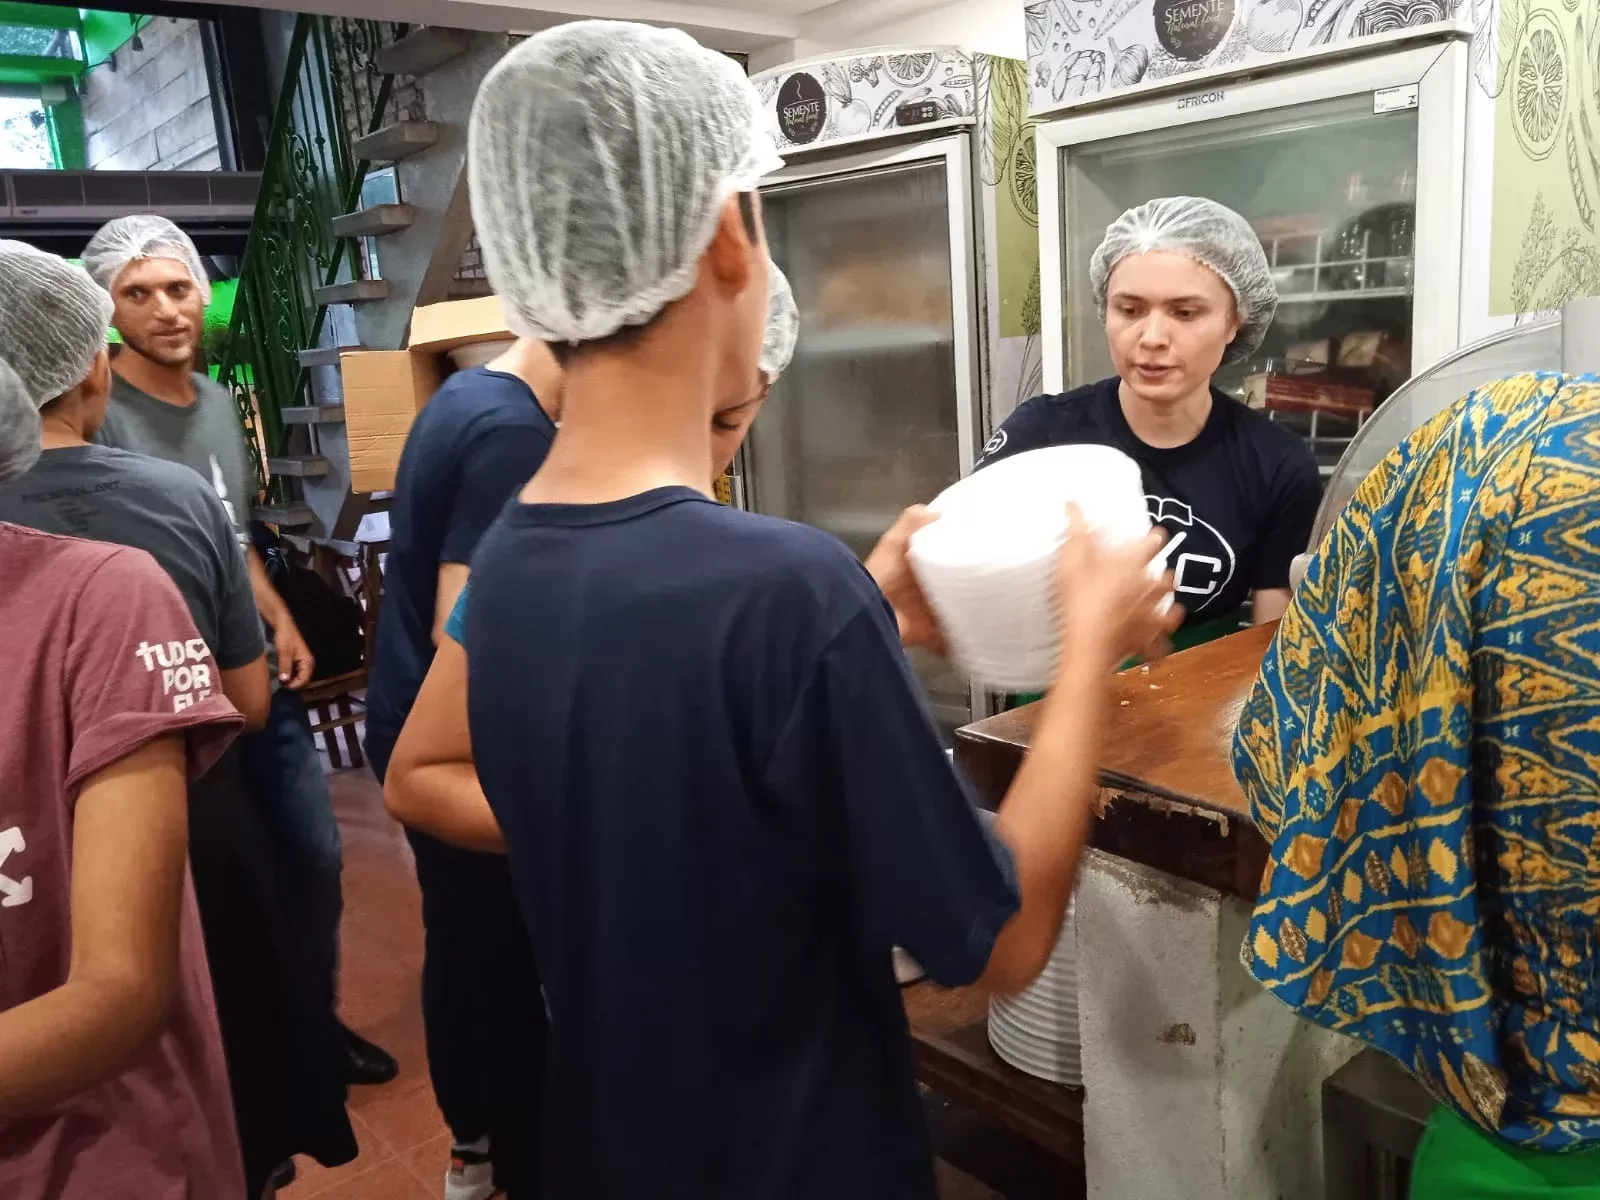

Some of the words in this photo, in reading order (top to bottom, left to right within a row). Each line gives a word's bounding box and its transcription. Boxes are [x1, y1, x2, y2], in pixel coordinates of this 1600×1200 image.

[1165, 0, 1224, 24] SEMENTE
[1185, 90, 1225, 109] FRICON
[783, 102, 821, 120] SEMENTE
[162, 663, 211, 696] POR
